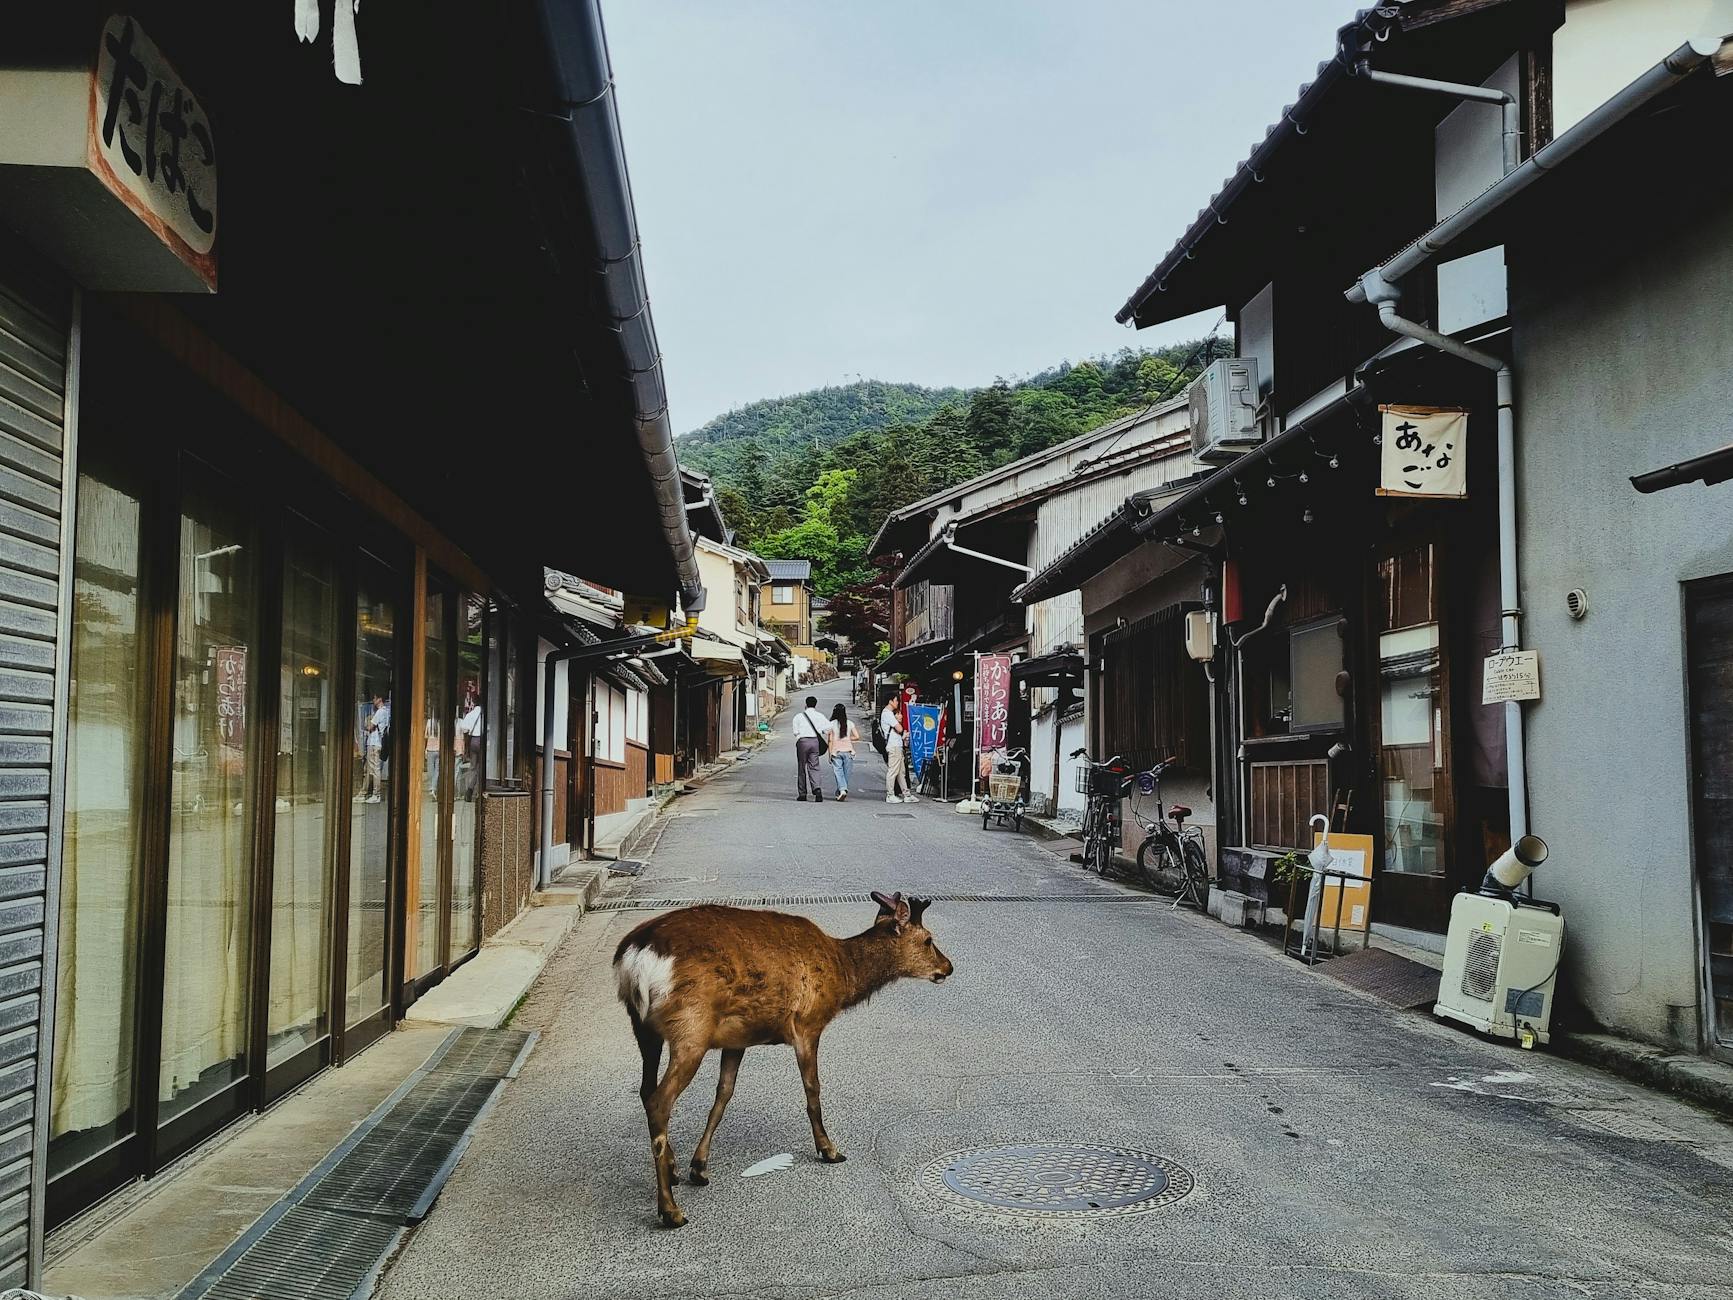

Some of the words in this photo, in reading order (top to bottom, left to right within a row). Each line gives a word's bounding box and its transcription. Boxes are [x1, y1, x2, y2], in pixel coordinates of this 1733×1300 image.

[103, 16, 214, 234] たばこ
[1395, 421, 1454, 489] あなご
[990, 660, 1009, 743] からあげ
